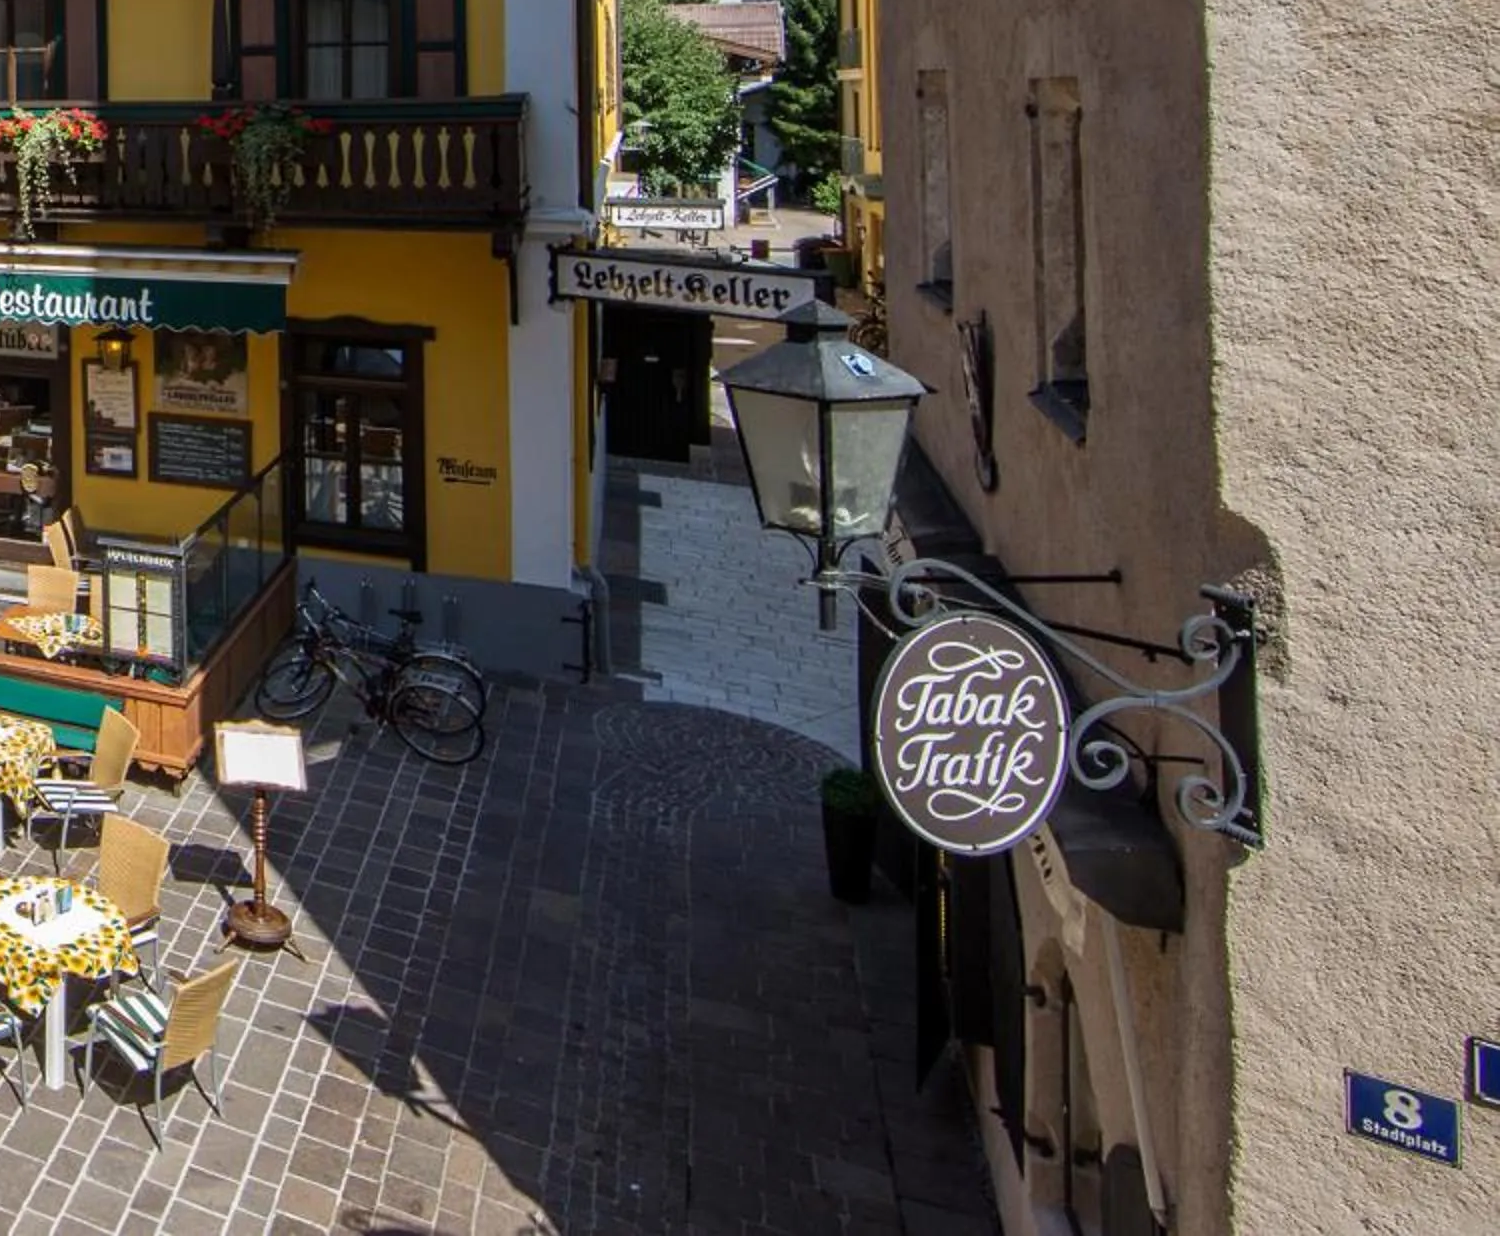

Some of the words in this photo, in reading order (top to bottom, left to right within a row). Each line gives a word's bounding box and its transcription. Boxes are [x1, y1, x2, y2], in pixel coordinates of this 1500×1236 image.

[895, 671, 1046, 732] Tabak
[895, 731, 1045, 794] Trafik
[1382, 1088, 1423, 1130] 8
[1361, 1116, 1448, 1157] Stadtplatz
